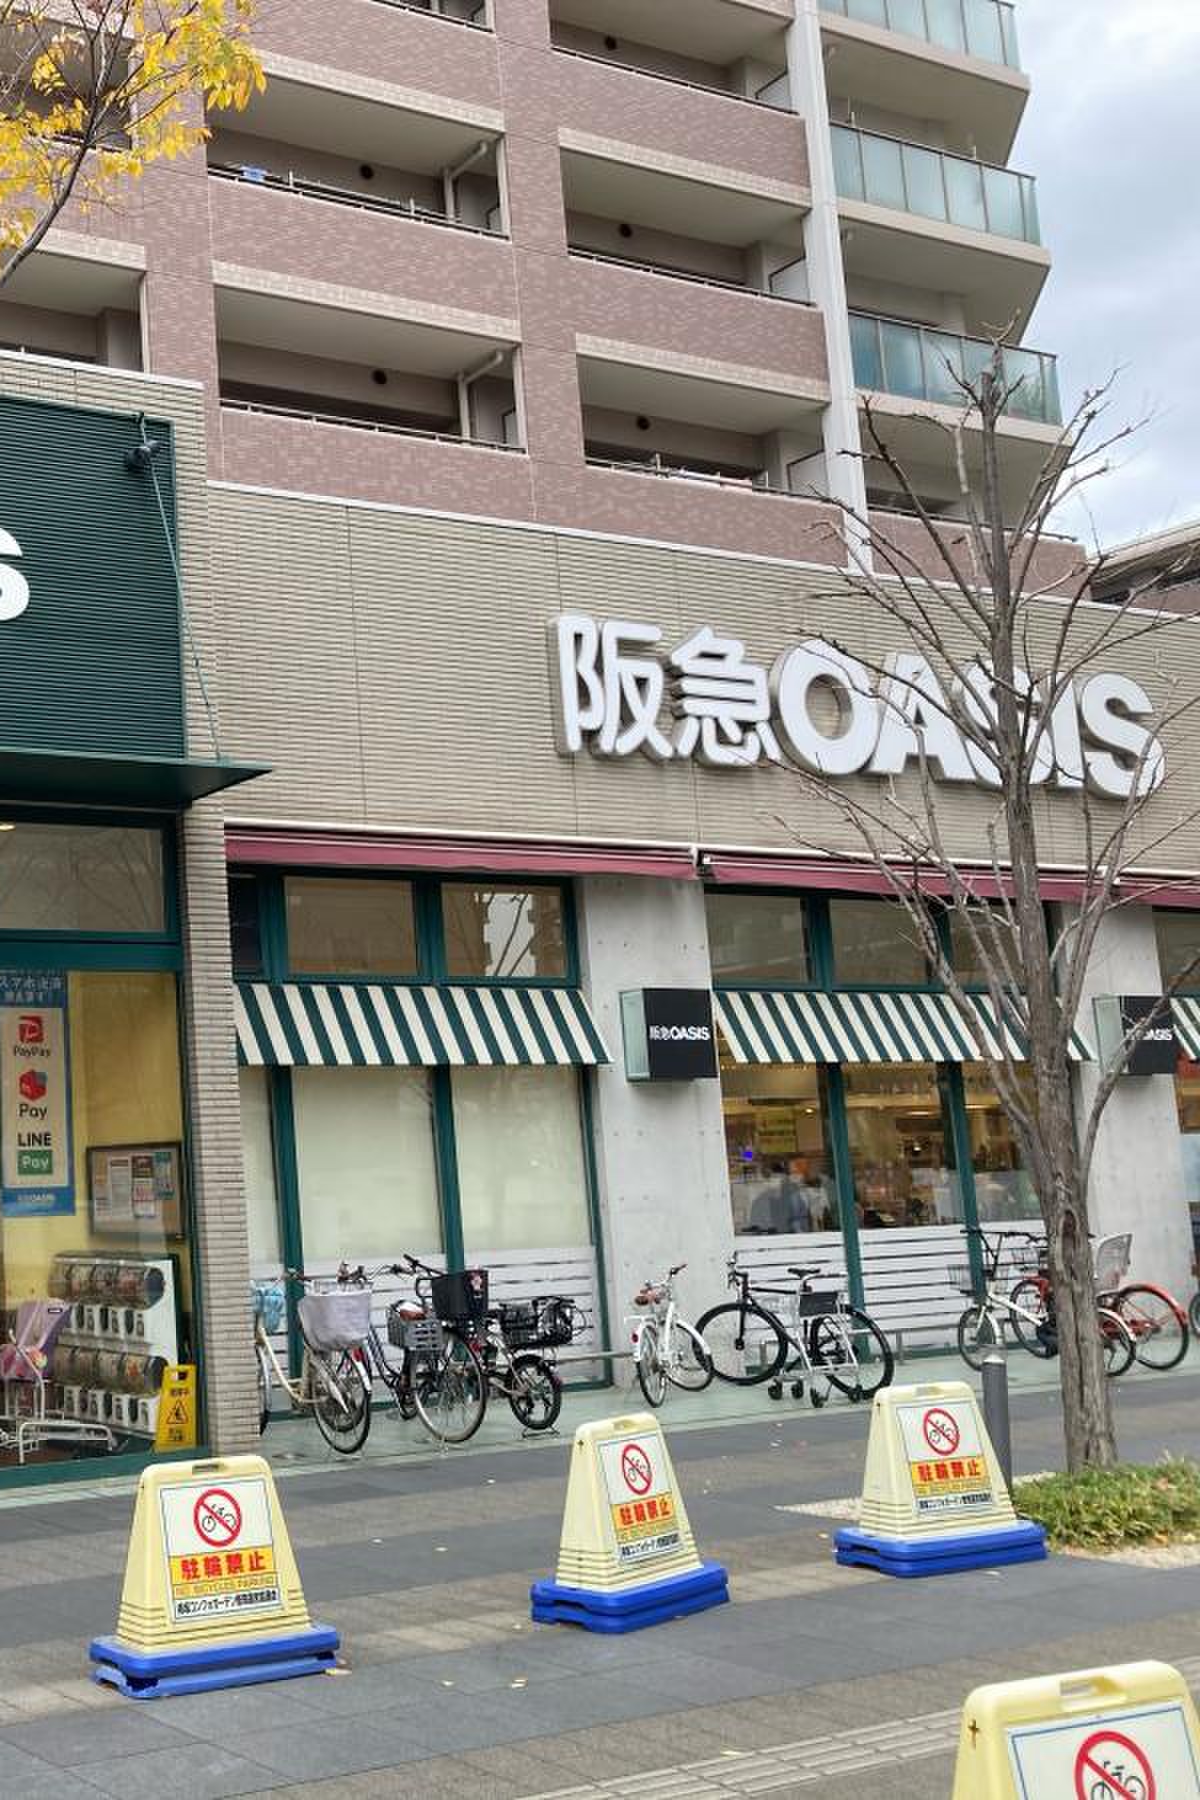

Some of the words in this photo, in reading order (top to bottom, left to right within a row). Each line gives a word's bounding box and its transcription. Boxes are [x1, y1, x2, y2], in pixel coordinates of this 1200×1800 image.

[556, 612, 1165, 798] 阪急OASIS
[19, 1104, 47, 1120] Pay
[18, 1132, 52, 1147] LINE
[21, 1156, 49, 1170] Pay
[180, 1551, 267, 1581] 駐輪禁止
